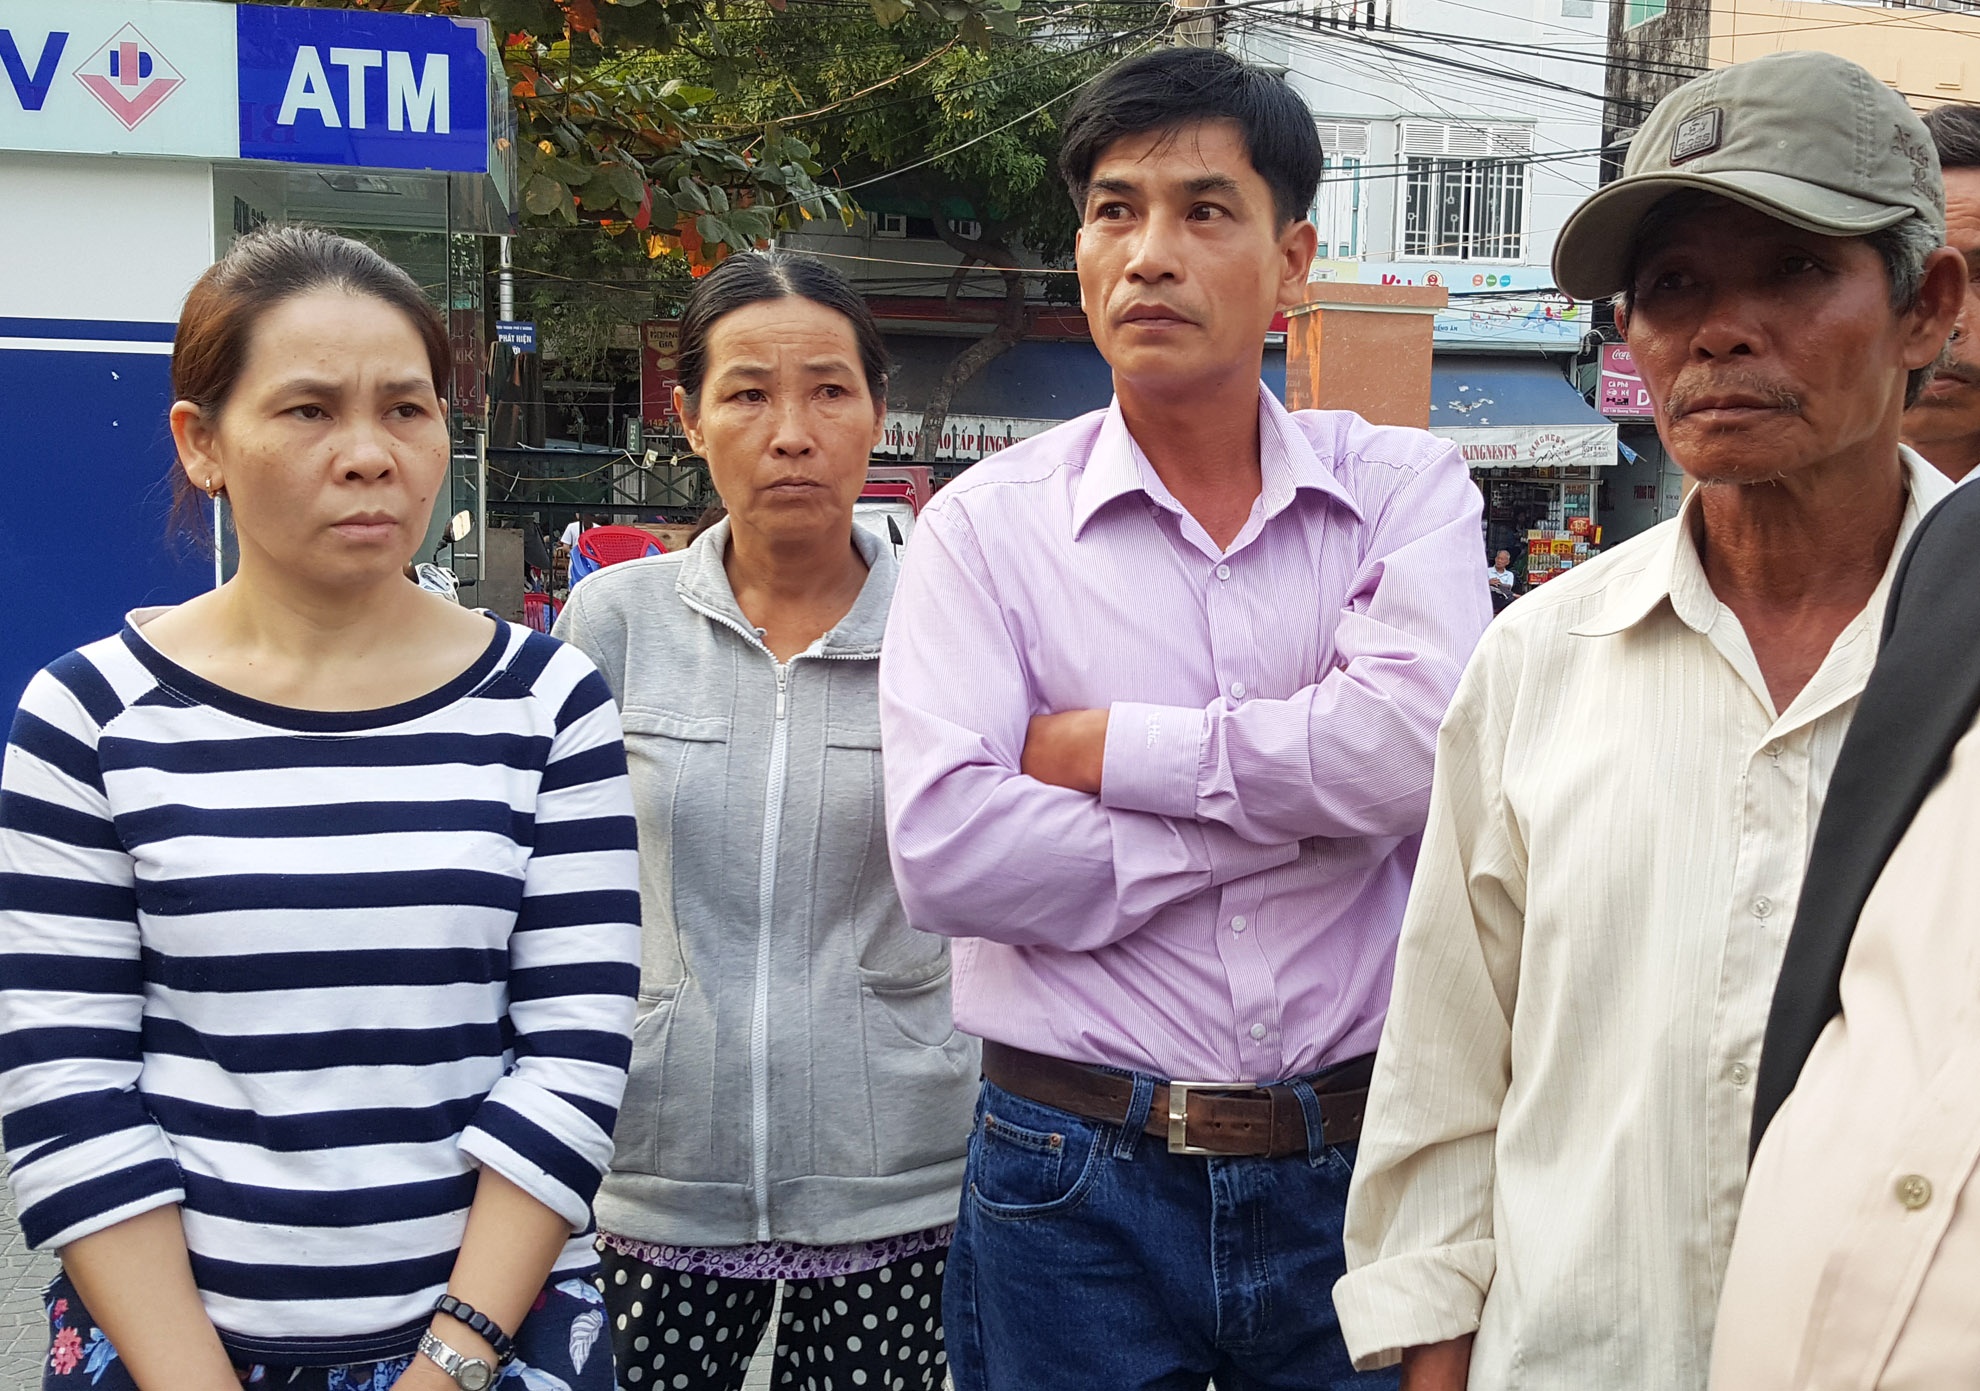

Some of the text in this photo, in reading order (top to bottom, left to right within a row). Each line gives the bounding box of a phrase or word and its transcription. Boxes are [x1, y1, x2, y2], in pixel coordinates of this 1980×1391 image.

[0, 29, 450, 134] V ATM
[498, 333, 532, 345] PHÁT HIỆN
[1462, 444, 1517, 460] KINGNEST'S
